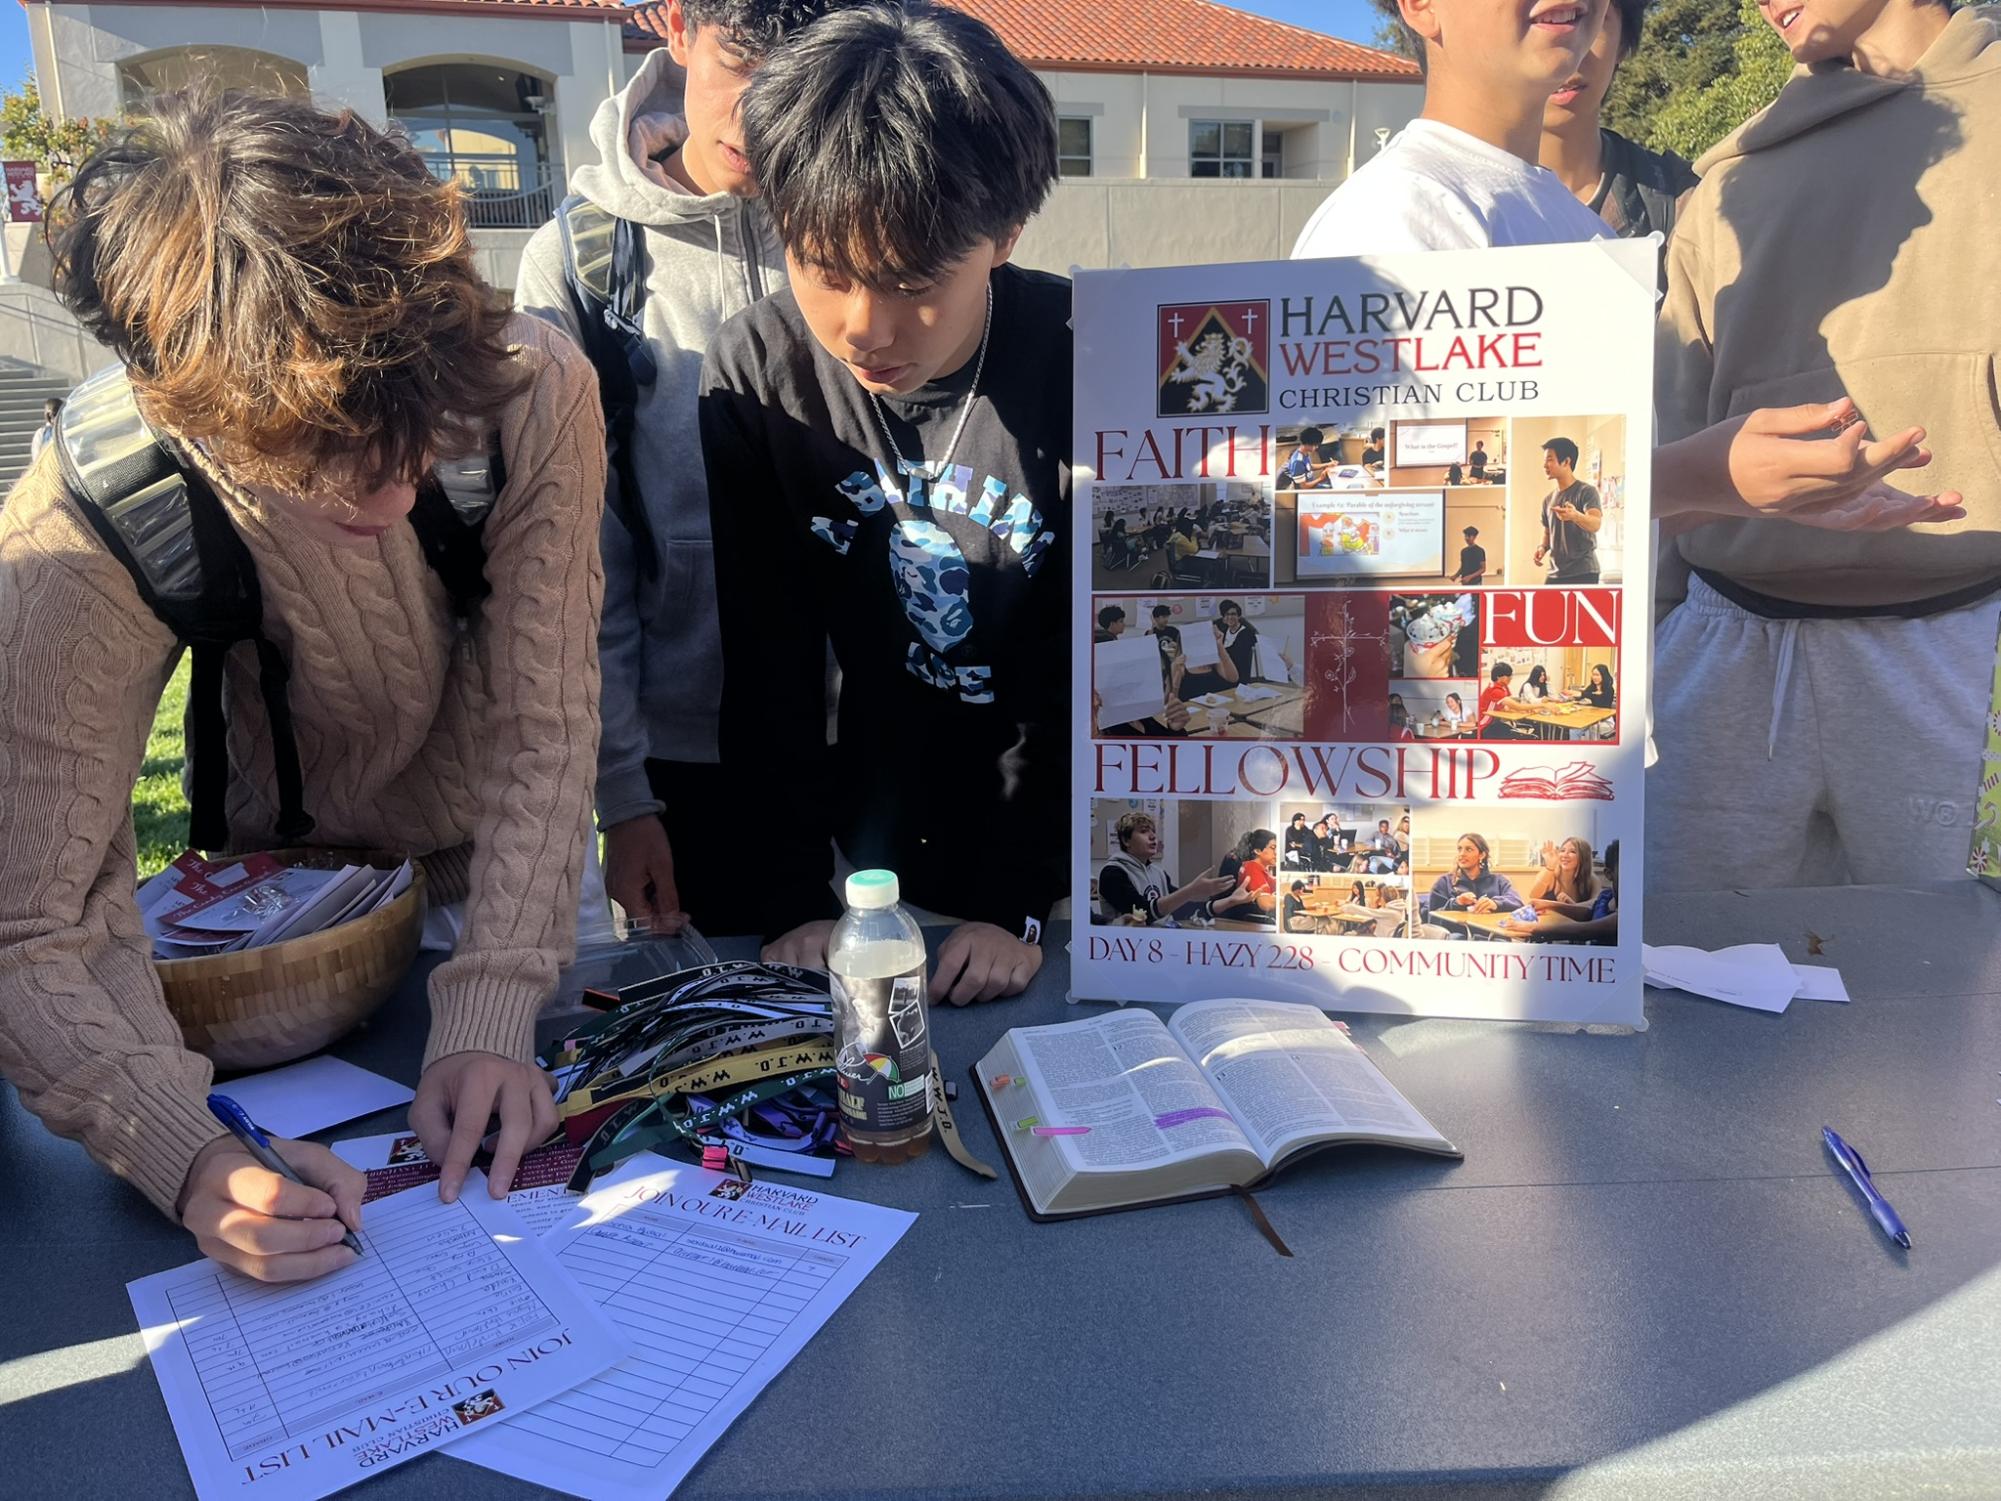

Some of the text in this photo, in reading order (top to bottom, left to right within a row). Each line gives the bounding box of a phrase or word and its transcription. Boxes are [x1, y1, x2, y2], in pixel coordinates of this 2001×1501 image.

[1280, 286, 1543, 338] HARVARD
[1279, 332, 1543, 377] WESTLAKE
[1279, 380, 1539, 409] CHRISTIAN CLUB
[1095, 425, 1270, 481] FAITH
[1482, 591, 1617, 645] FUN
[1094, 743, 1501, 799] FELLOWSHIP
[1088, 936, 1146, 962] DAY
[1148, 937, 1164, 963] 8
[1185, 941, 1261, 968] HAZY
[1267, 944, 1315, 971] 228
[1338, 947, 1533, 983] COMMUNITY
[1539, 955, 1616, 985] TIME
[889, 1085, 905, 1099] NO
[625, 1185, 677, 1210] JOIN
[680, 1197, 729, 1223] OUR
[811, 1227, 867, 1249] LIST
[746, 1191, 814, 1211] WESTLAKE
[751, 1184, 819, 1204] HARVARD
[502, 1327, 579, 1370] JOIN
[429, 1361, 506, 1404] OUR
[310, 1392, 428, 1455] E-MAIL
[352, 1412, 454, 1462] WESTLAKE
[357, 1418, 459, 1472] HARVARD
[235, 1441, 310, 1486] LIST
